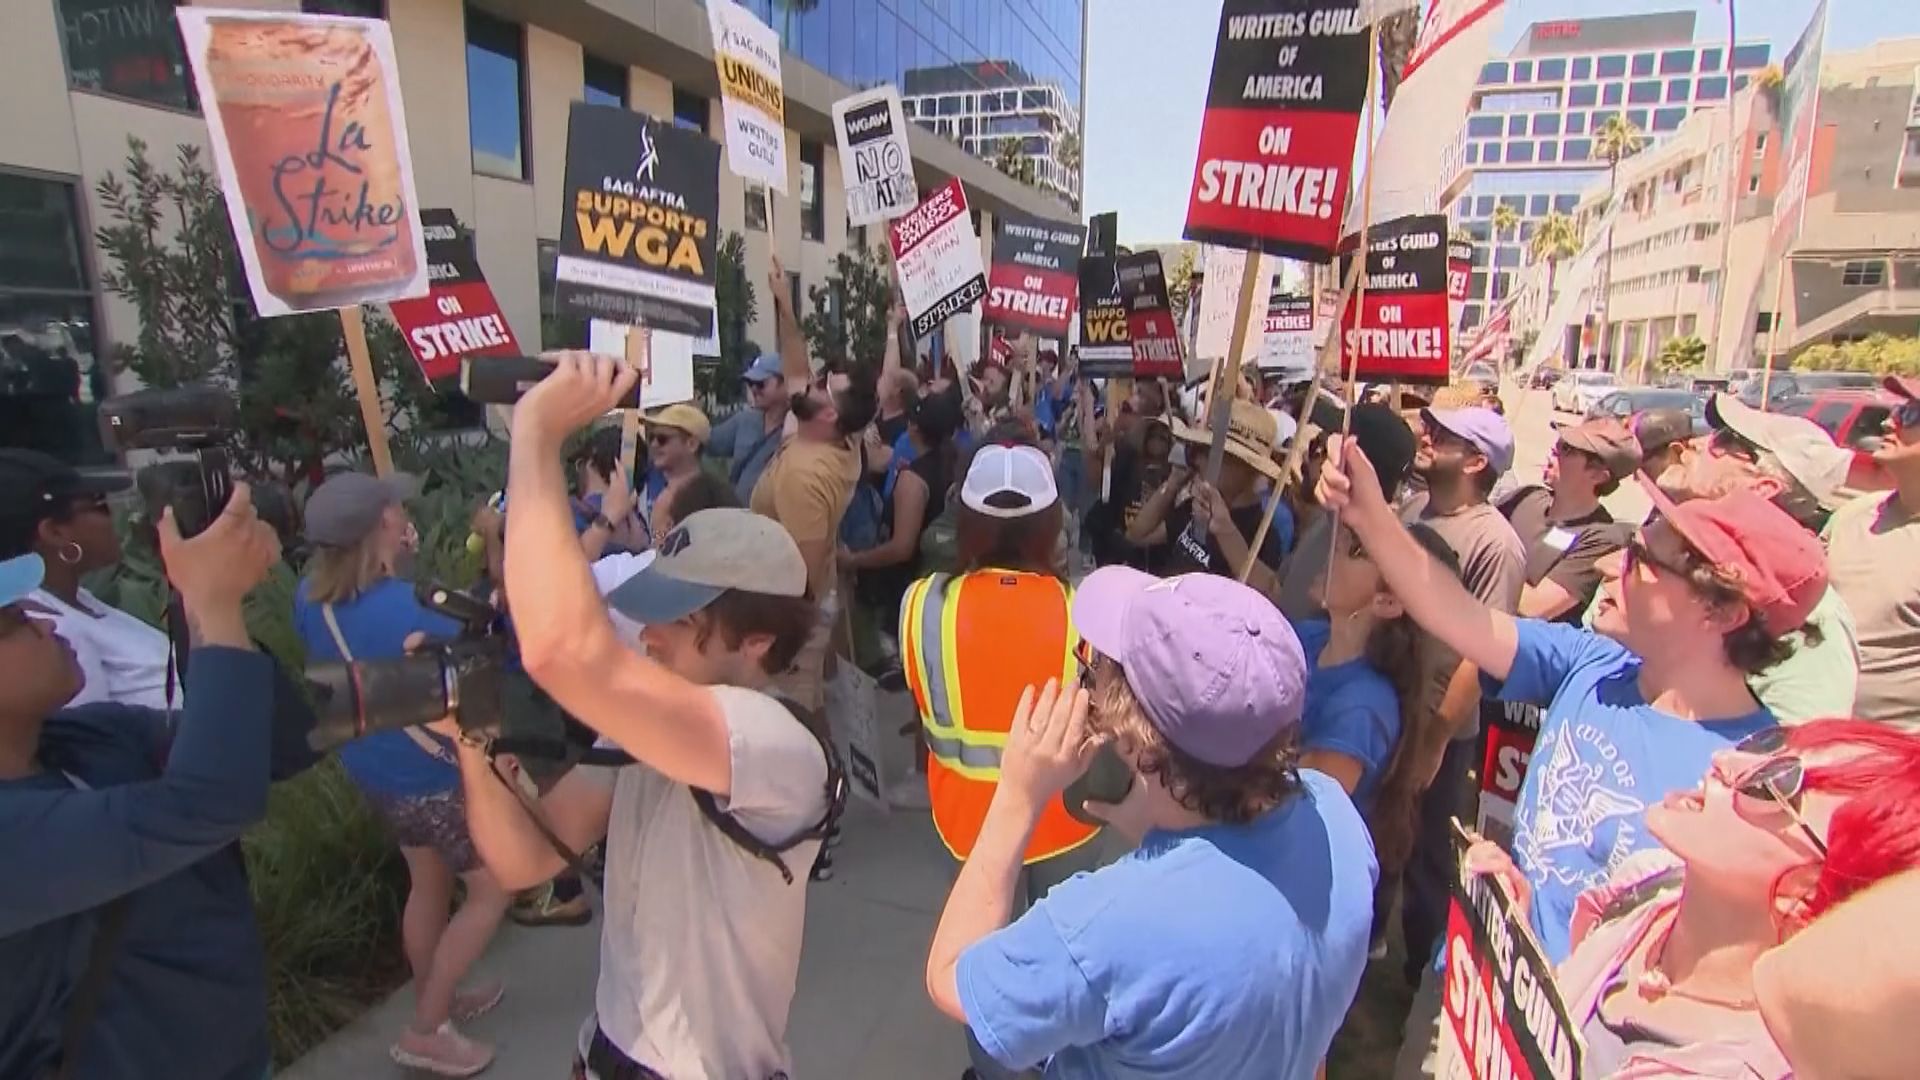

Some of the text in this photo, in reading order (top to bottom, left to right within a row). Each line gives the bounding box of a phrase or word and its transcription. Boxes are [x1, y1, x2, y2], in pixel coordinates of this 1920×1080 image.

[1228, 12, 1306, 40] WRITERS
[1278, 46, 1298, 67] OF
[723, 56, 781, 109] UNIONS
[1243, 75, 1323, 100] AMERICA
[306, 81, 372, 174] La
[847, 111, 889, 135] WGAW
[1259, 125, 1292, 155] ON
[855, 141, 903, 185] NO
[263, 154, 404, 252] Strike
[1198, 159, 1338, 219] STRIKE!
[577, 189, 707, 238] SUPPORTS
[895, 186, 953, 234] WRITERS
[576, 210, 704, 276] WGA
[900, 204, 960, 254] AMERICA
[1005, 223, 1080, 246] WRITERS GUILD
[1400, 231, 1439, 250] GUILD
[428, 262, 460, 279] ERICA
[1014, 251, 1059, 269] AMERICA
[1382, 256, 1396, 269] OF
[1024, 276, 1043, 290] ON
[437, 296, 463, 315] ON
[918, 280, 982, 335] STRIKE
[989, 286, 1068, 319] STRIKE!
[1086, 308, 1125, 321] SUPPO
[1379, 305, 1402, 323] ON
[1086, 319, 1130, 342] WG
[1264, 314, 1311, 330] STRIKE!
[411, 313, 510, 361] STRIKE!
[1613, 760, 1636, 788] OF
[1513, 955, 1574, 1080] GUILD
